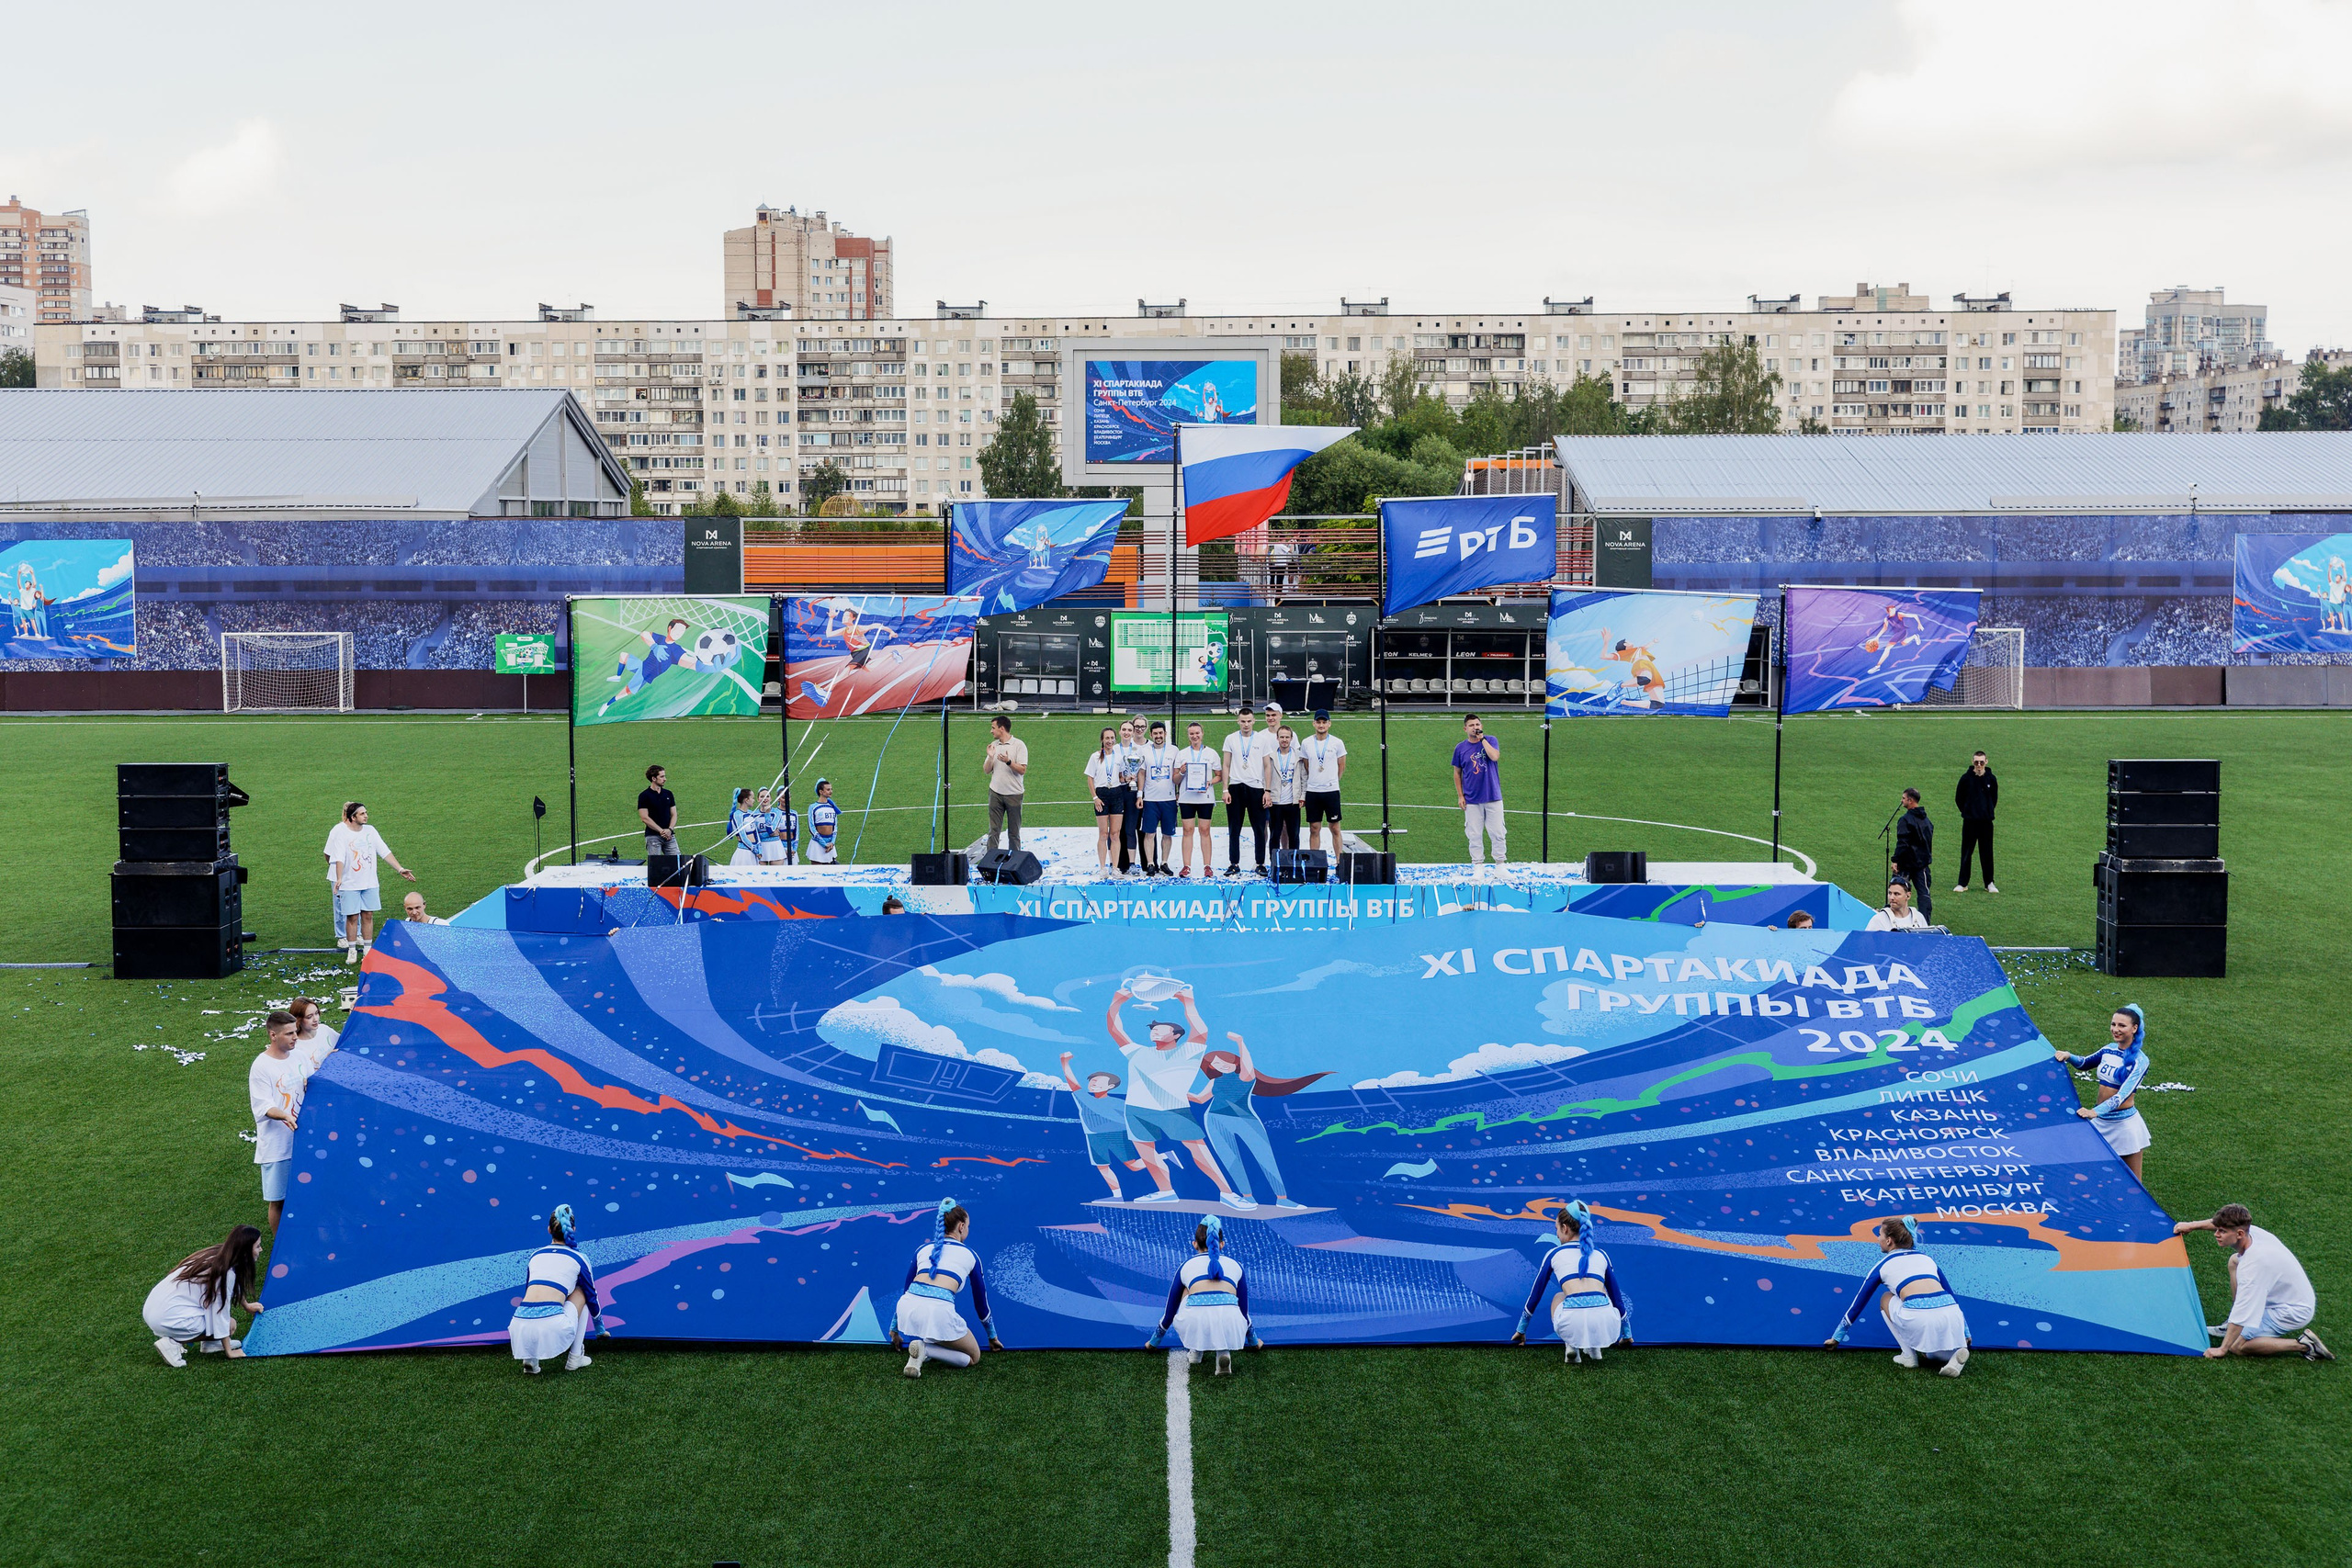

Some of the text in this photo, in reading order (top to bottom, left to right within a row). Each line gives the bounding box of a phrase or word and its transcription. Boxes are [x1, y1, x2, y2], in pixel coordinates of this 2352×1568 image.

[1103, 380, 1162, 389] СПАРТАКИАДА
[1093, 399, 1157, 408] Санкт-Петербург
[1016, 899, 1415, 922] XI СПАРТАКИАДА ГРУППЫ ВТБ
[1419, 945, 1931, 990] XI СПАРТАКИАДА
[1566, 984, 1937, 1020] ГРУППЫ ВТБ
[1797, 1027, 1959, 1054] 2024
[1905, 1070, 1980, 1083] СОЧИ
[2100, 1064, 2119, 1076] ВТ
[1879, 1089, 1989, 1104] ЛИПЕЦК
[1890, 1110, 1998, 1122] КАЗАНЬ
[1828, 1127, 2010, 1141] КРАСНОЯРСК
[1815, 1145, 2023, 1163] ВЛАДИВОСТОК
[1785, 1164, 2031, 1183] САНКТ-ПЕТЕРБУРГ
[1840, 1182, 2045, 1202] ЕКАТЕРИНБУРГ
[1935, 1201, 2061, 1219] МОСКВА
